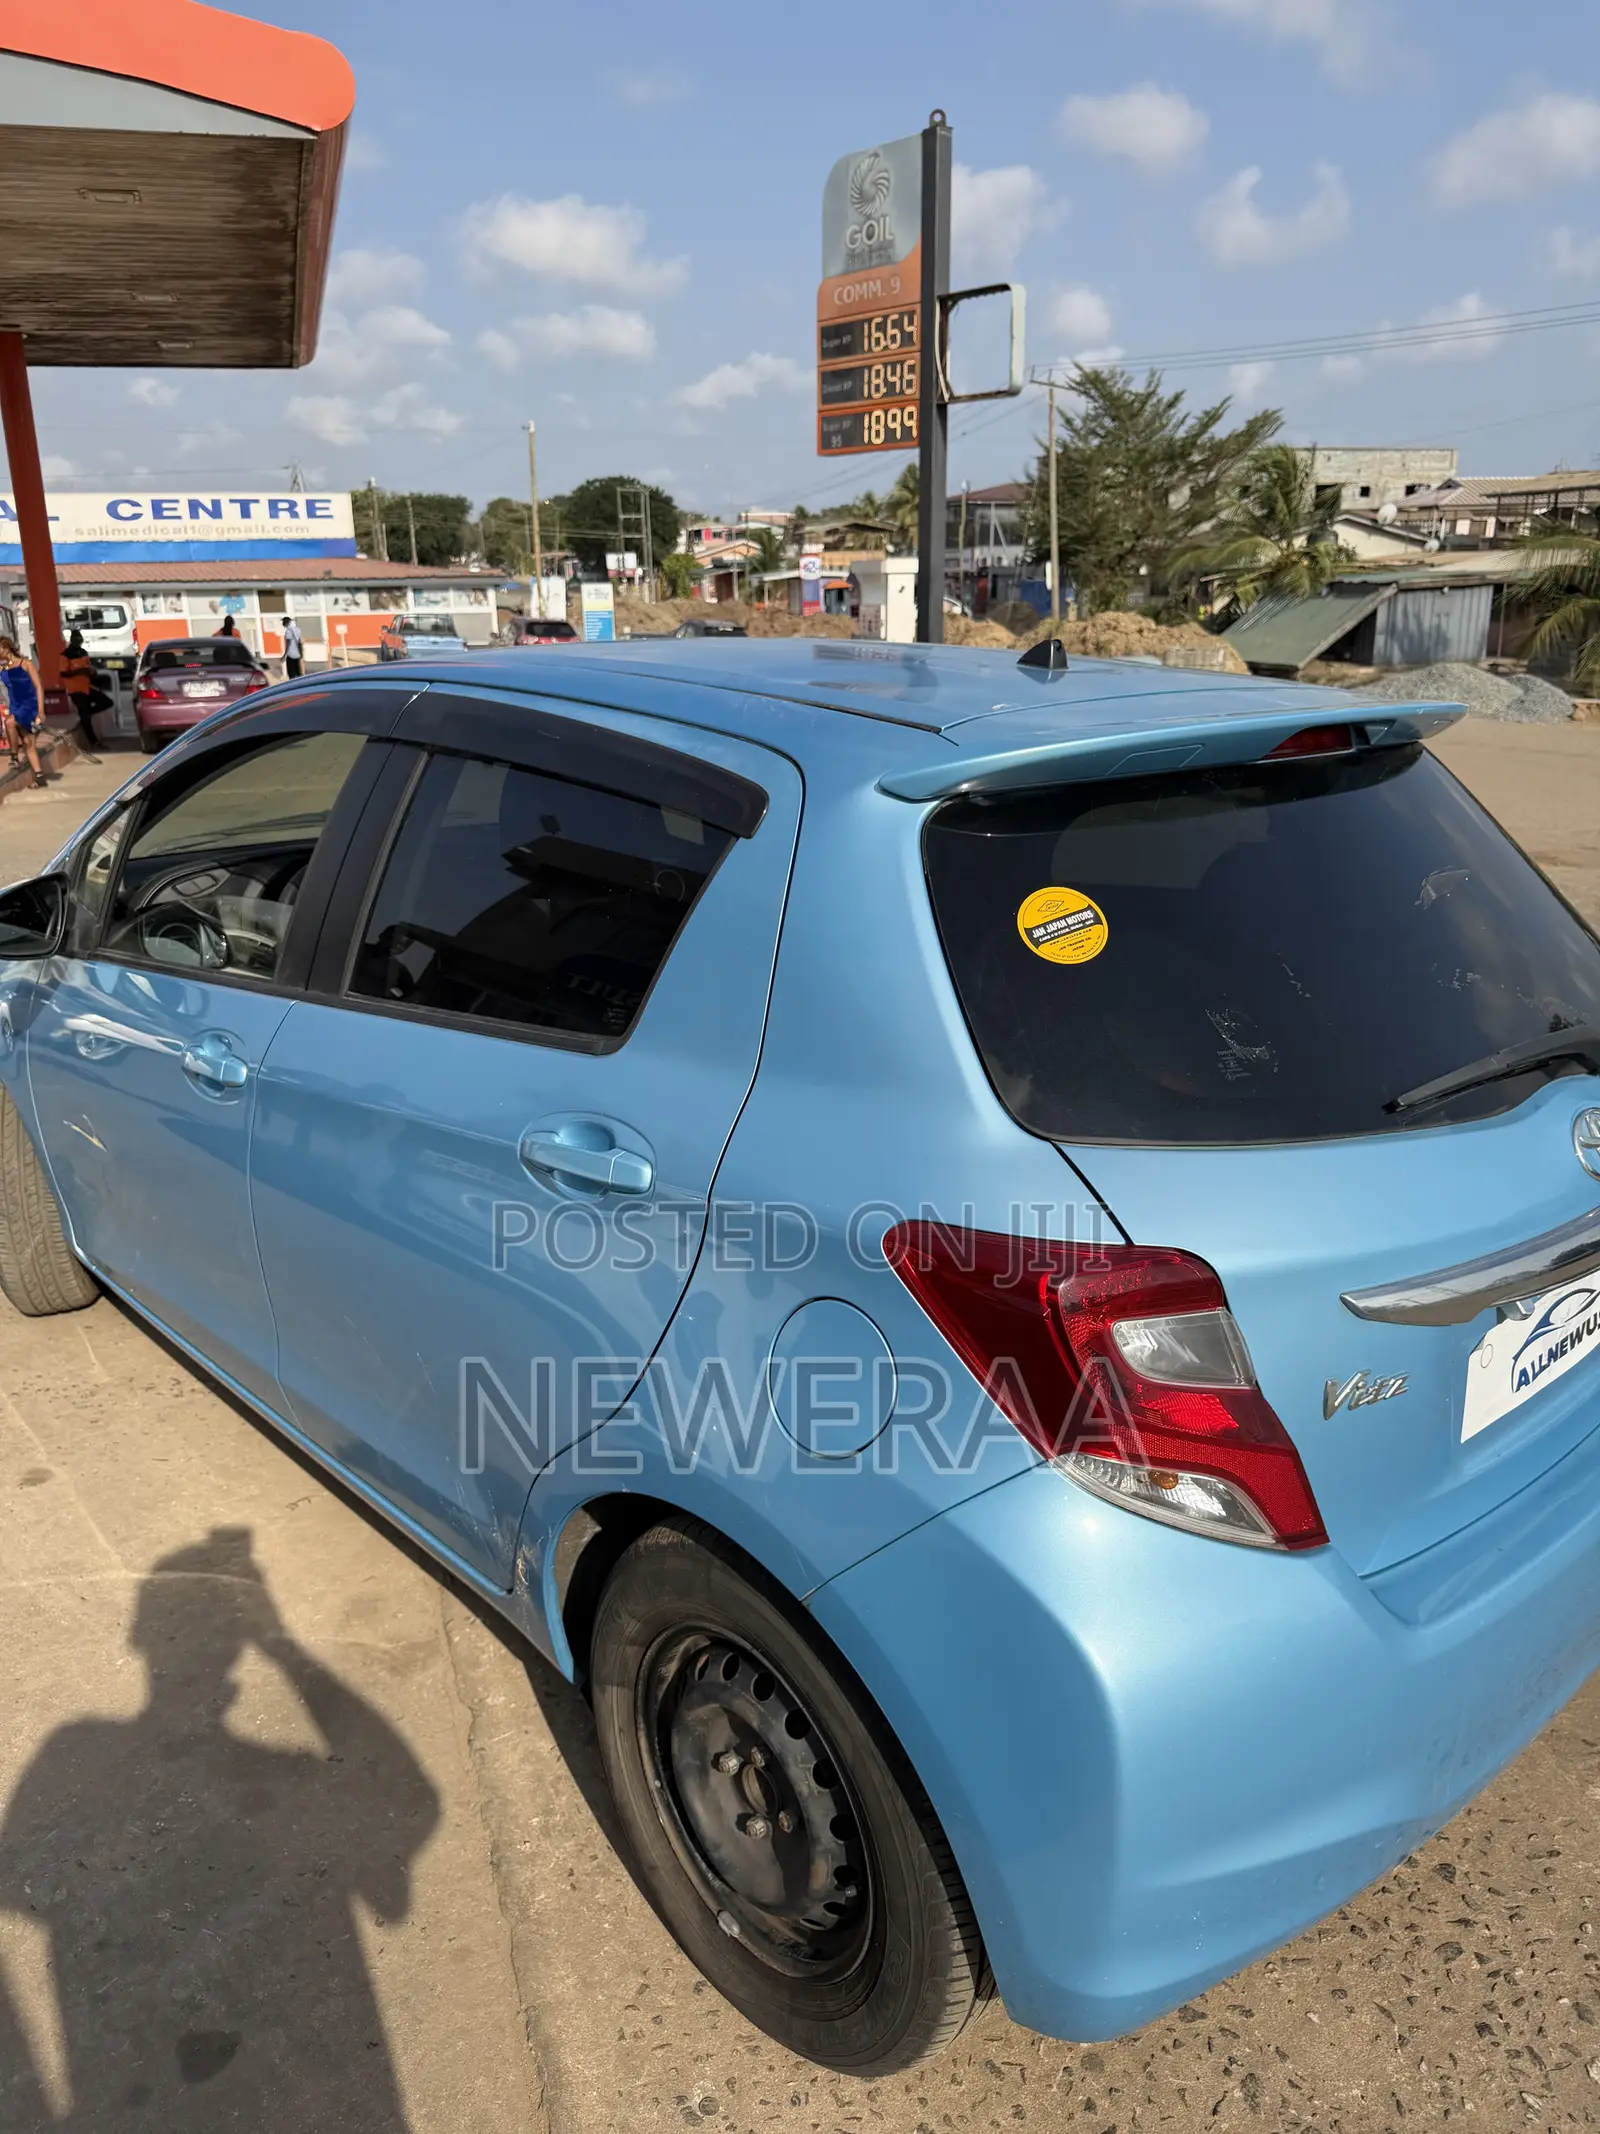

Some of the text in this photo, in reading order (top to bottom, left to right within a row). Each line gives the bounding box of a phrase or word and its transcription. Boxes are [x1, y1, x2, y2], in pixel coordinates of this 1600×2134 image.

[845, 215, 894, 249] GOIL
[833, 275, 900, 305] COMM. 9
[106, 498, 334, 521] CENTRE
[1046, 919, 1067, 933] JAPAN
[1065, 910, 1094, 925] MOTORS
